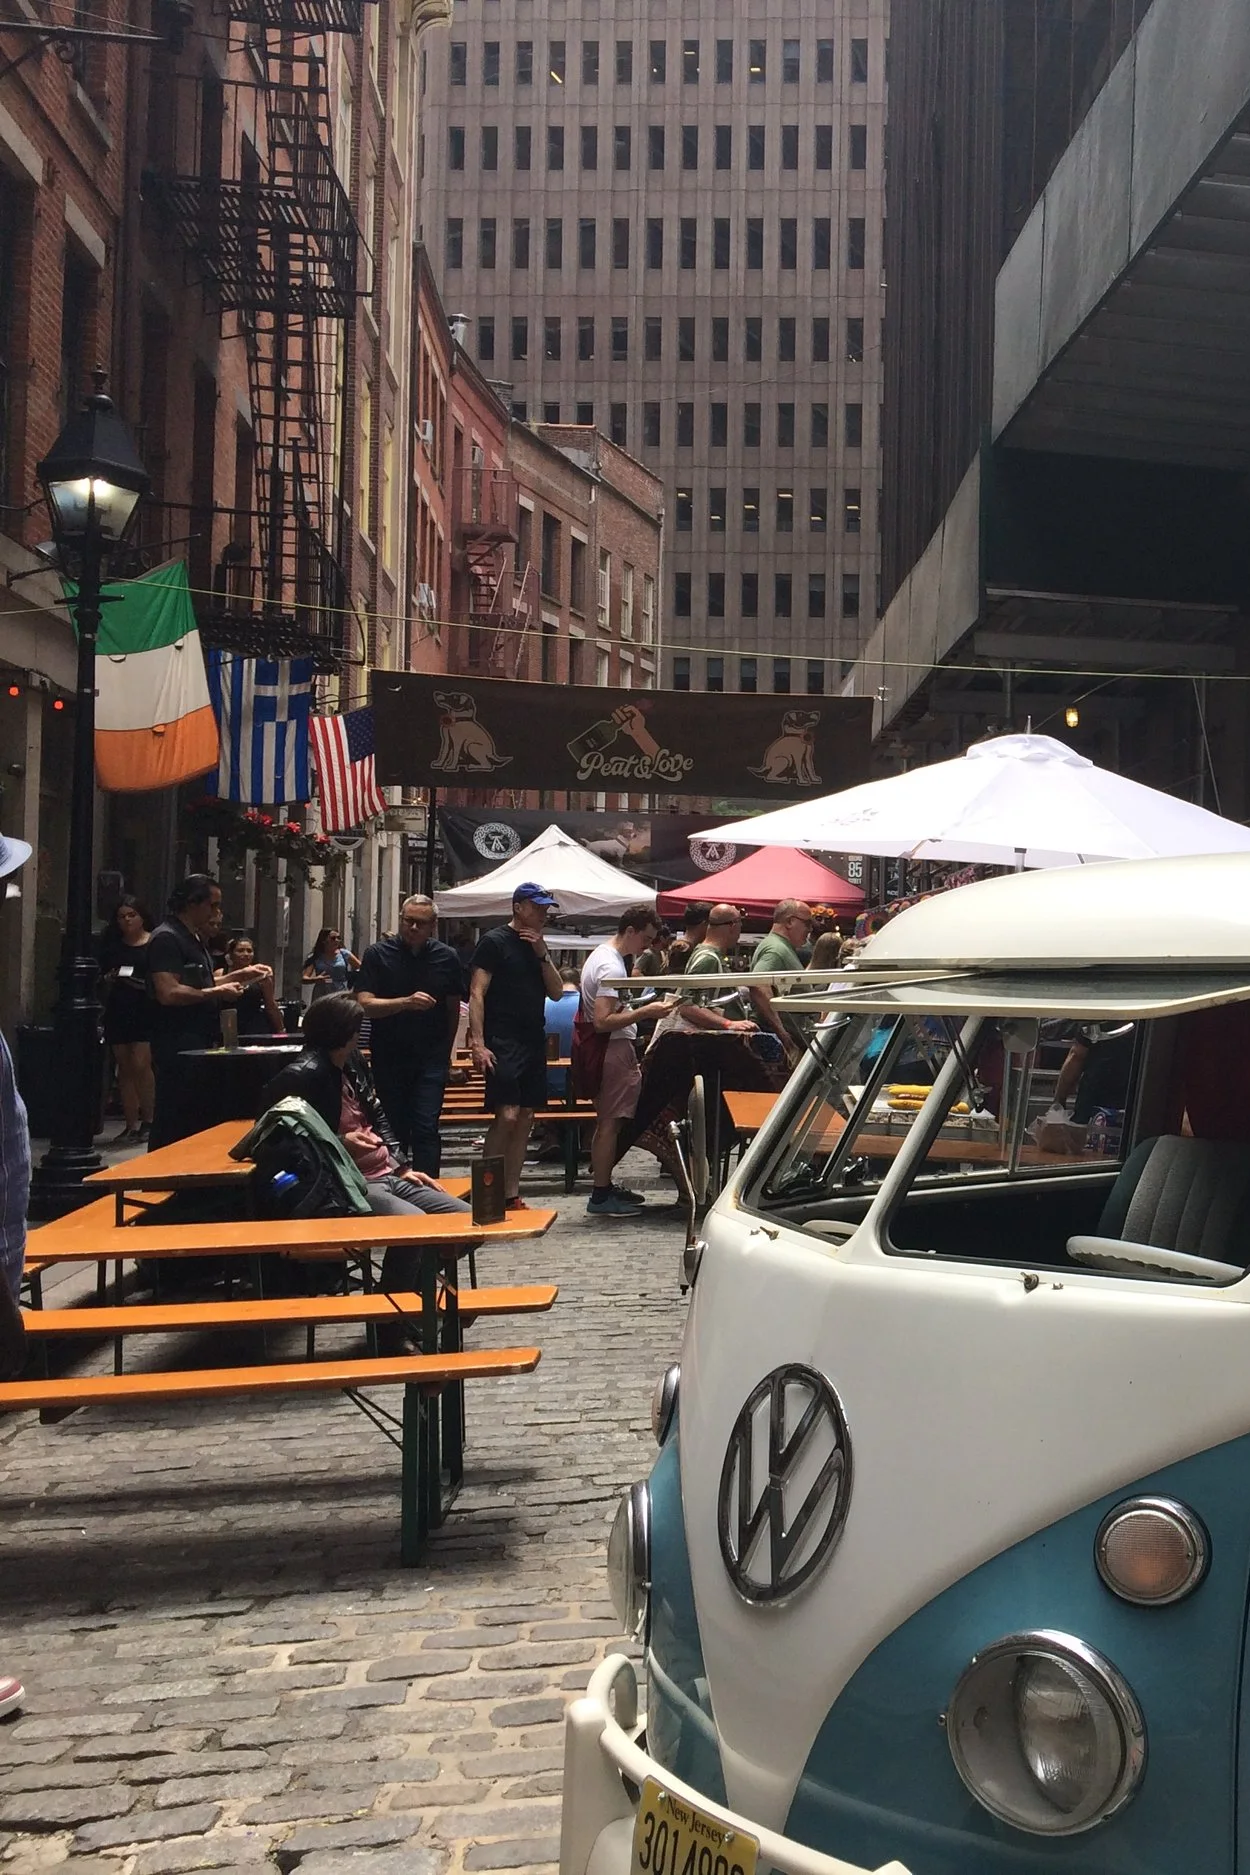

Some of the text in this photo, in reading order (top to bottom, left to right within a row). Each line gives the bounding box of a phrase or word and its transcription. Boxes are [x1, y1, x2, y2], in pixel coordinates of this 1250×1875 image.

[848, 861, 862, 878] 85
[666, 1795, 724, 1849] New Jersey
